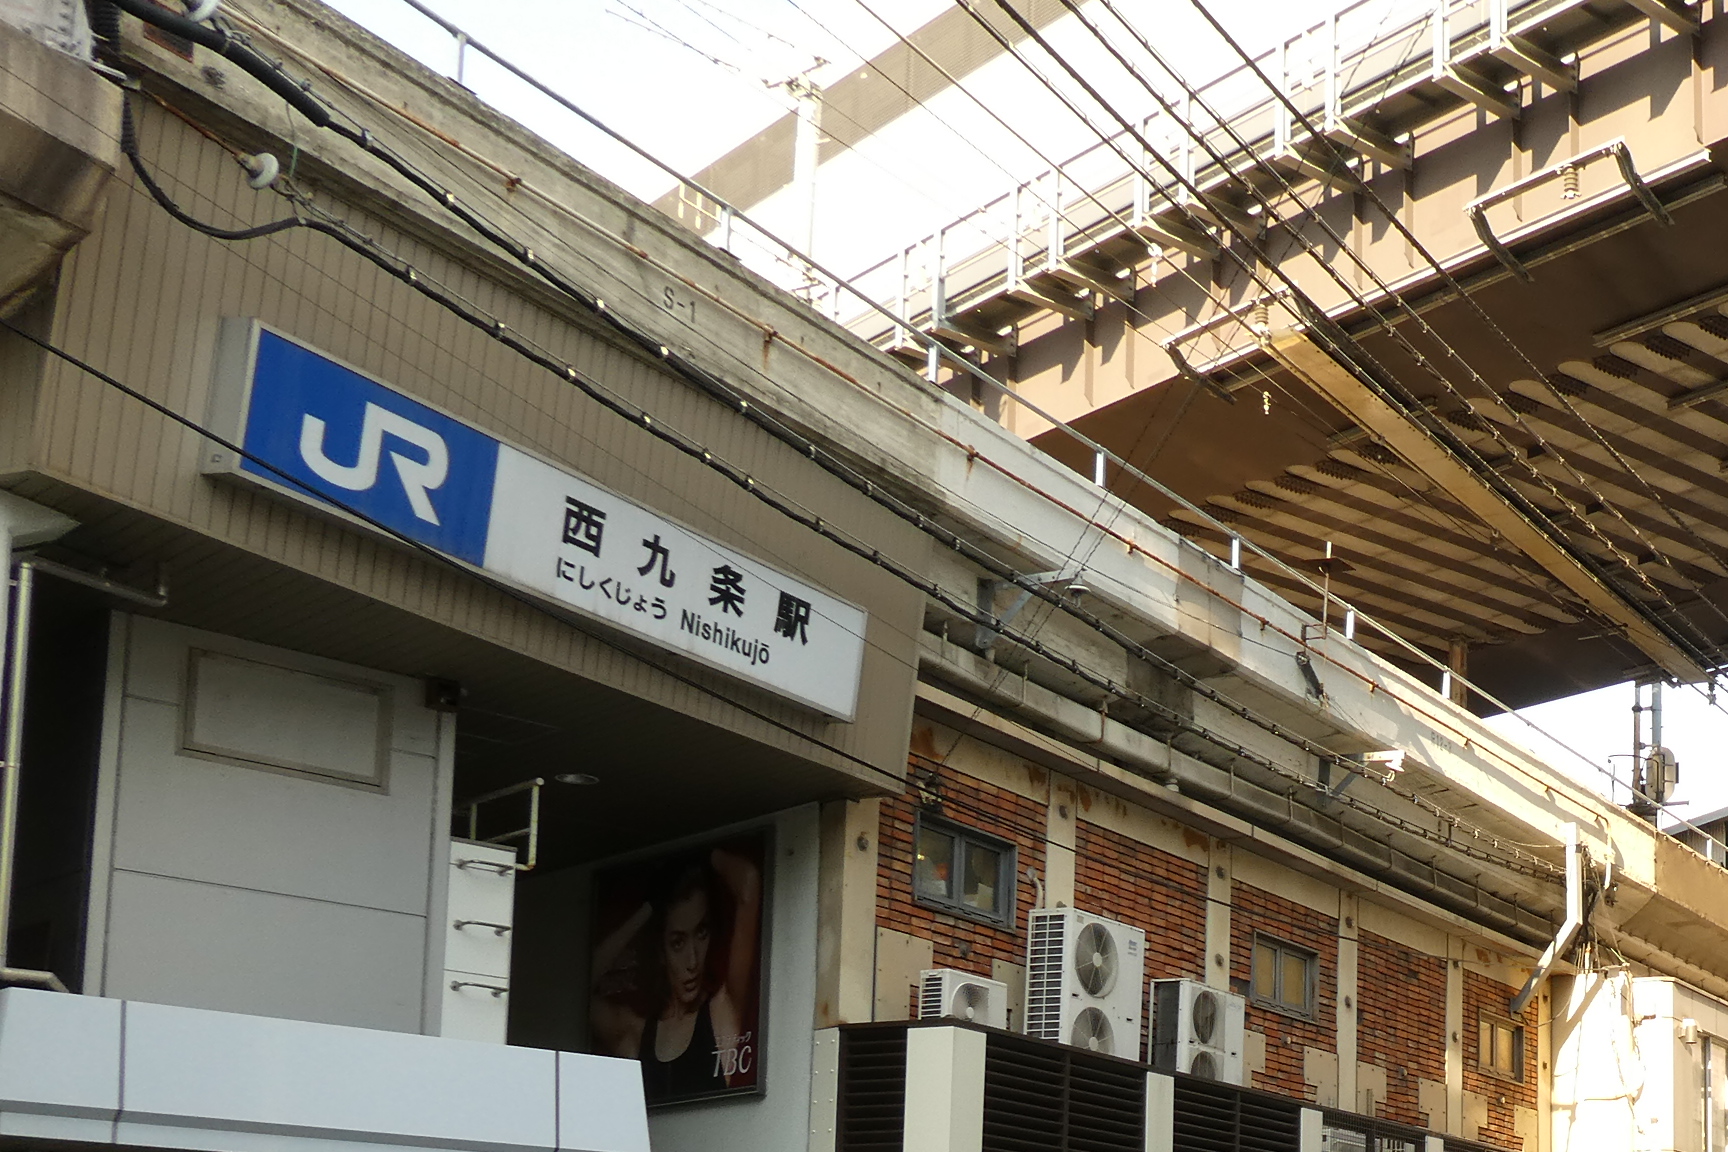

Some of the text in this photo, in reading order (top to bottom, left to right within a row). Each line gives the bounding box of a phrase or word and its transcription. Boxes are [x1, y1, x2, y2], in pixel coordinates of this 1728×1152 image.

[663, 286, 697, 323] S-1
[299, 401, 449, 526] JR
[556, 558, 668, 620] にしくじょう
[562, 496, 811, 646] 西九条駅
[711, 1045, 752, 1078] TBC
